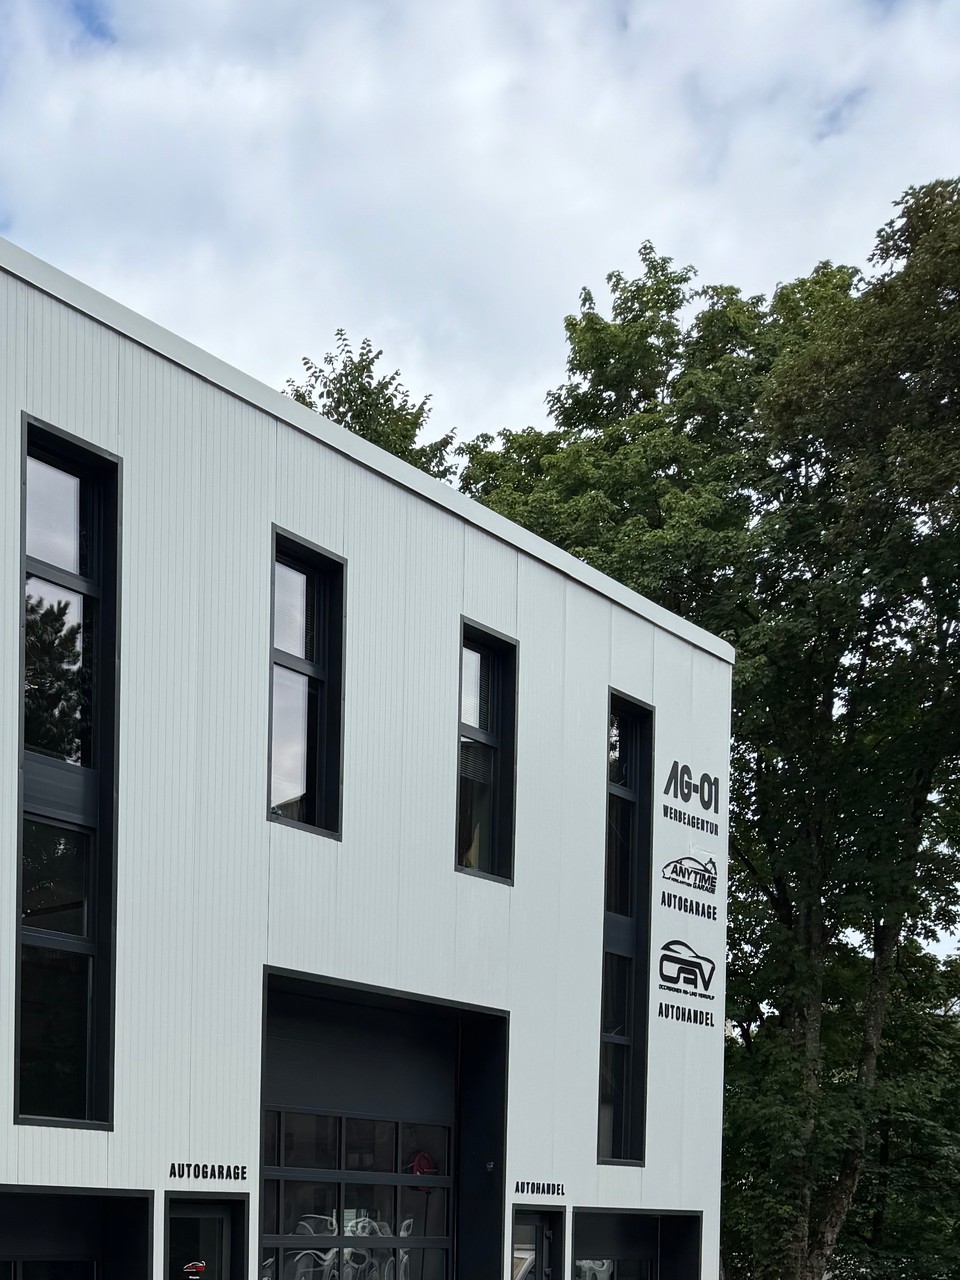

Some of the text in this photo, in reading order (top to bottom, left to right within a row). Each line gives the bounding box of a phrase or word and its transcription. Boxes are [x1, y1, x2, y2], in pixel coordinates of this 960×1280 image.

[663, 760, 720, 814] AG-01
[663, 804, 719, 836] WERBEAGENTUR
[671, 864, 717, 888] ANYTIME
[692, 882, 716, 895] GARAGE
[660, 890, 718, 921] AUTOGARAGE
[658, 1002, 715, 1027] AUTOHANDEL
[169, 1162, 247, 1181] AUTOGARAGE
[514, 1180, 566, 1196] AUTOHANDEL
